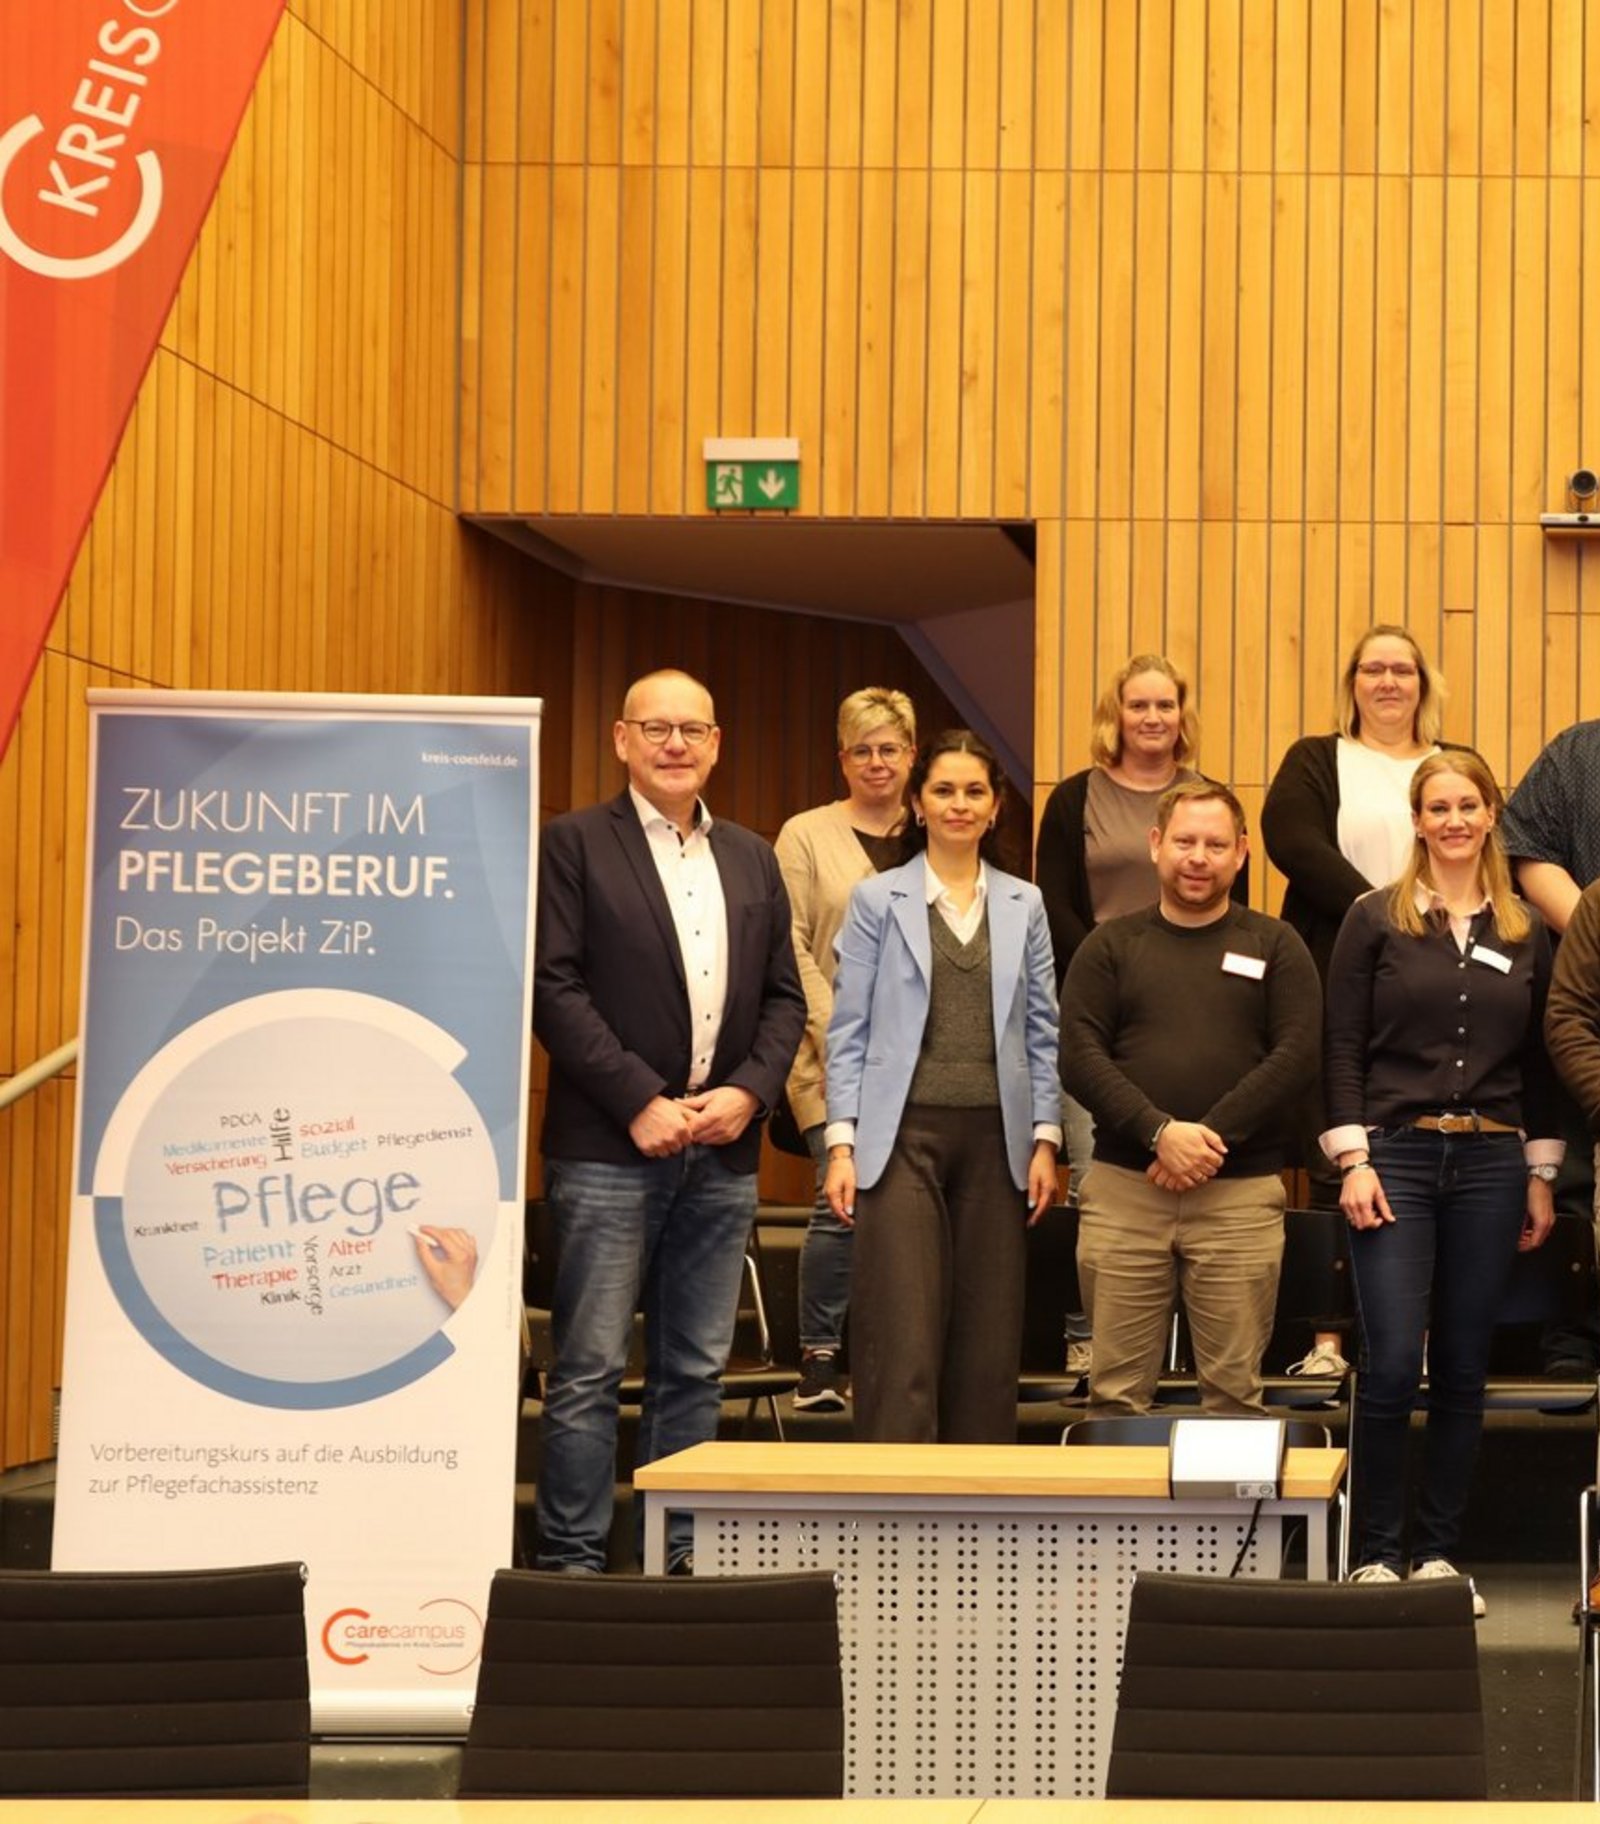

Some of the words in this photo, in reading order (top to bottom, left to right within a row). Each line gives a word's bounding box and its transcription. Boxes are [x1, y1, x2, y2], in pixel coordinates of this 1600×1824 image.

[119, 787, 351, 833] ZUKUNFT
[367, 793, 427, 836] IM
[118, 850, 455, 898] PFLEGEBERUF.
[115, 916, 182, 951] Das
[198, 916, 307, 963] Projekt
[319, 920, 376, 956] ZiP.
[219, 1113, 262, 1128] PDCA
[299, 1116, 355, 1137] sozial
[163, 1134, 268, 1157] Medikamente
[269, 1107, 293, 1163] Hilfe
[376, 1126, 473, 1148] Pflegedienst
[300, 1138, 368, 1158] Budget
[165, 1153, 267, 1176] Versicherung
[212, 1170, 421, 1237] Pflege
[134, 1221, 199, 1238] Krankheit
[201, 1240, 297, 1268] Patient
[328, 1238, 373, 1257] Alter
[212, 1266, 298, 1290] Therapie
[302, 1235, 324, 1317] Vorsorge
[329, 1264, 362, 1278] Arzt
[260, 1288, 301, 1305] Klinik
[329, 1274, 418, 1298] Gesundheit
[90, 1442, 270, 1468] Vorbereitungskurs
[276, 1443, 311, 1463] auf
[314, 1444, 344, 1463] die
[349, 1445, 459, 1470] Ausbildung
[89, 1478, 120, 1494] zur
[126, 1473, 319, 1500] Pflegefachassistenz
[344, 1624, 466, 1641] carecampus
